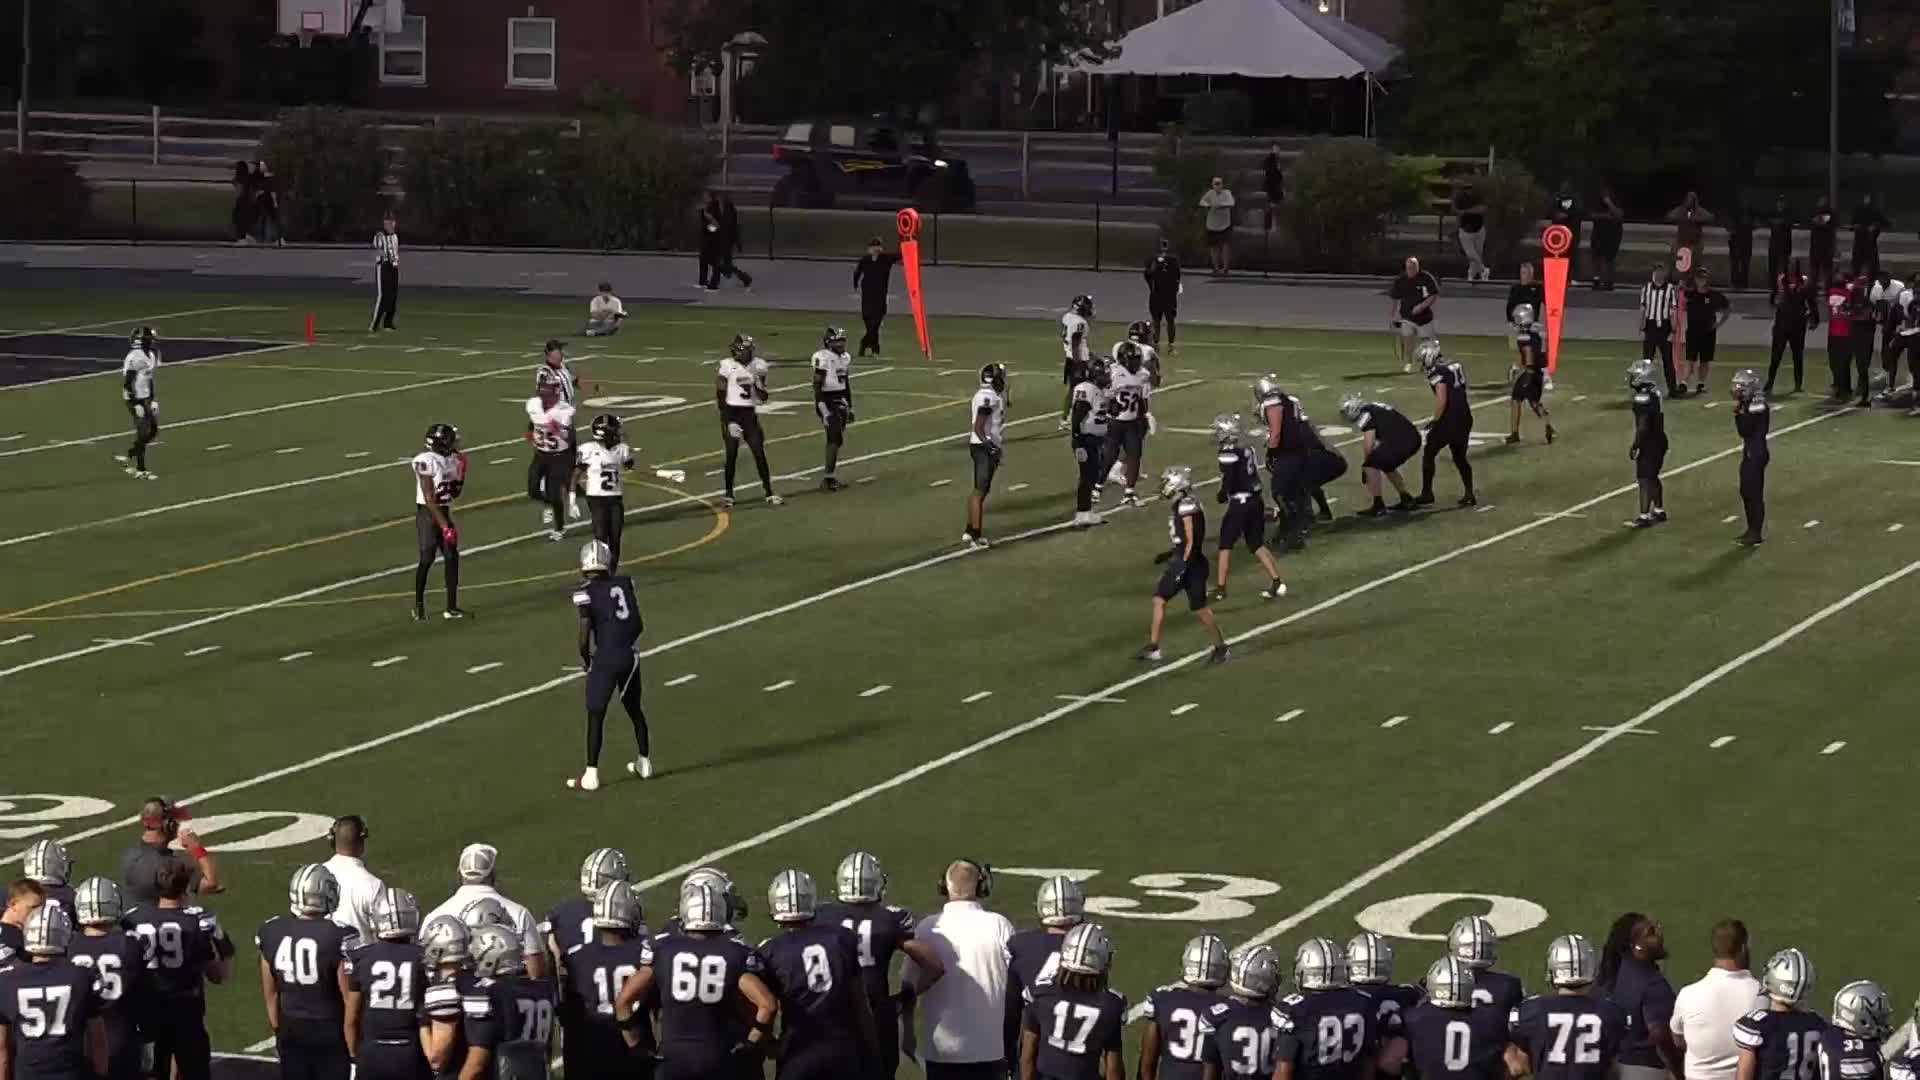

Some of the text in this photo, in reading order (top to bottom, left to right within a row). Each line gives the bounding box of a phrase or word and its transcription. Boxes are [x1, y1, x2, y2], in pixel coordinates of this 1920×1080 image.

[739, 383, 752, 400] 3
[610, 586, 630, 620] 3
[274, 936, 318, 986] 40
[370, 960, 415, 1010] 21
[672, 951, 728, 1005] 68
[17, 985, 72, 1038] 57
[1048, 1001, 1104, 1055] 17
[1318, 1013, 1367, 1066] 83
[1445, 1020, 1472, 1069] 0
[1547, 1012, 1602, 1065] 72
